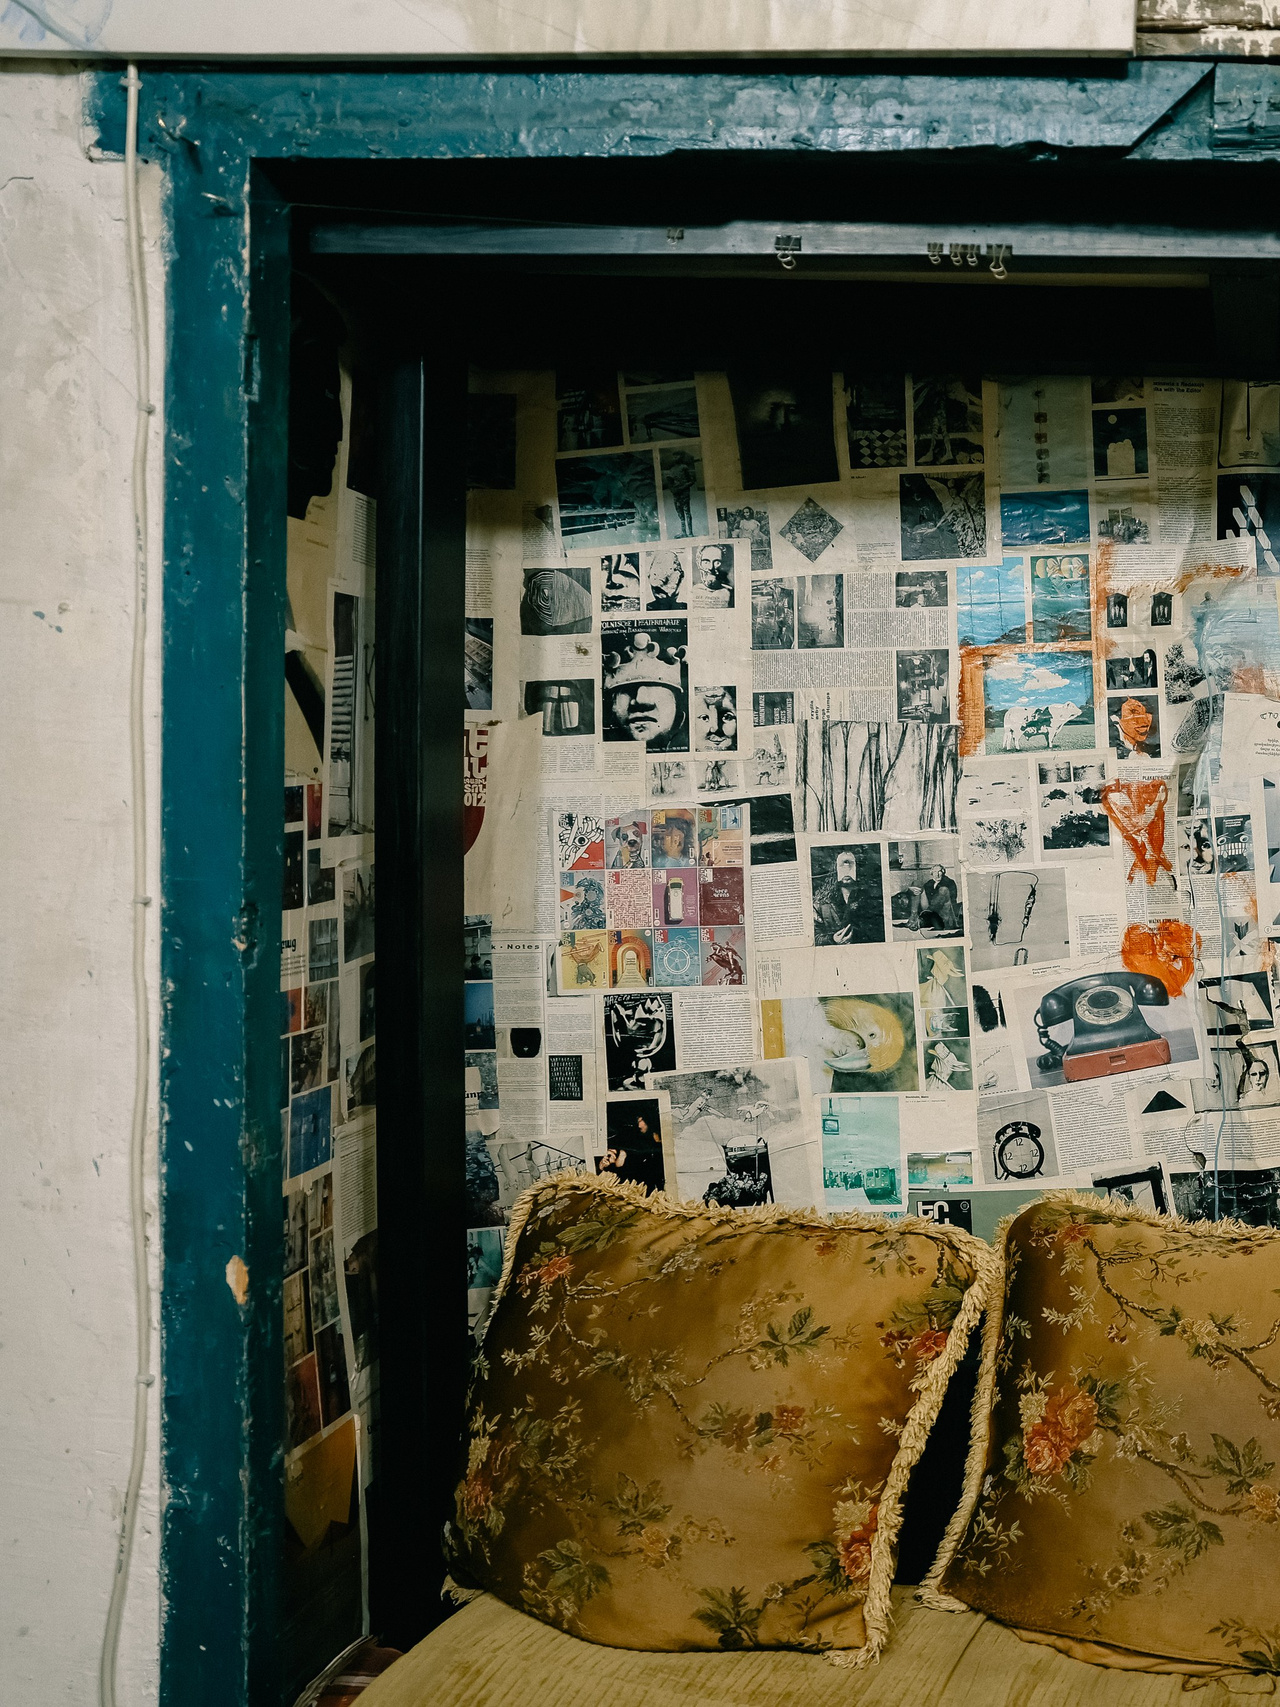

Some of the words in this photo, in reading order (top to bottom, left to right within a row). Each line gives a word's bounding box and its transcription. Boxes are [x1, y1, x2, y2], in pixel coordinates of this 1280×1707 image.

[1014, 1138, 1024, 1147] 12
[1004, 1152, 1013, 1161] 12
[1030, 1149, 1039, 1158] 12
[1019, 1164, 1028, 1173] 12
